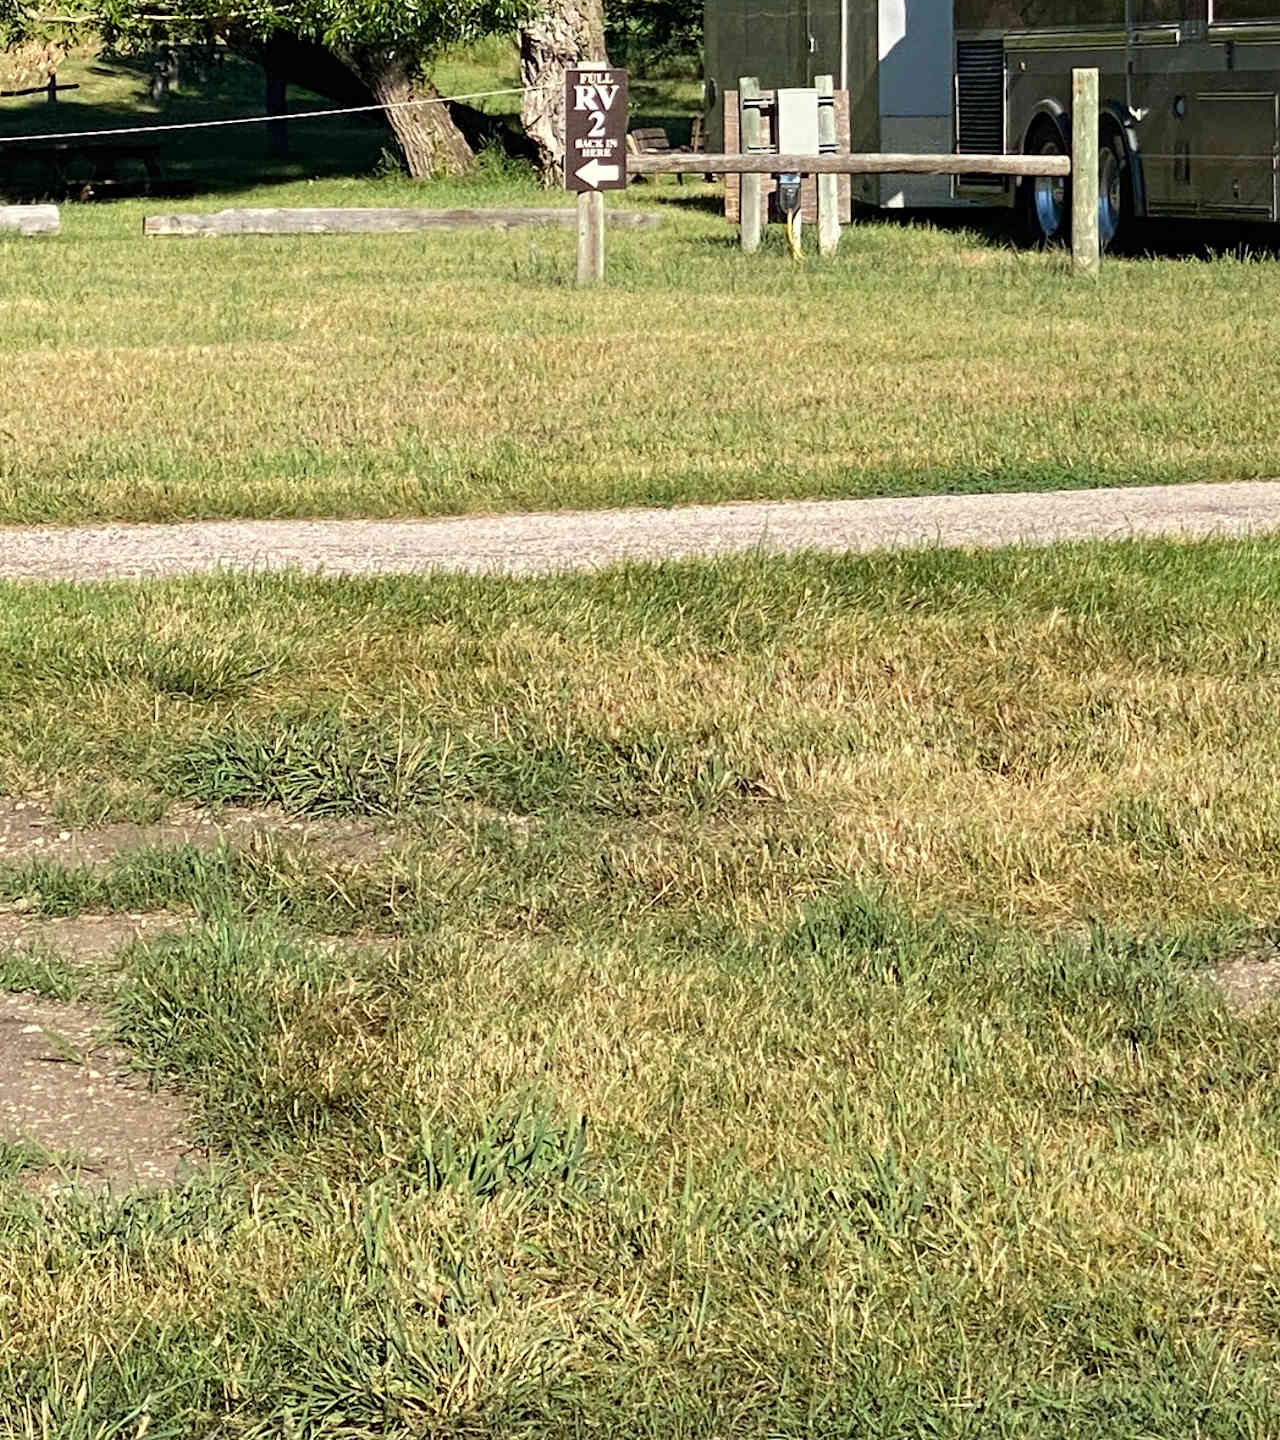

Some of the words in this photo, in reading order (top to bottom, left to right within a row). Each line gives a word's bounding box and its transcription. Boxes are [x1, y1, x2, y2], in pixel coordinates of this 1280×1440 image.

[580, 72, 614, 85] FULL
[573, 85, 620, 111] RV
[587, 111, 606, 137] 2
[575, 138, 604, 149] BACK
[605, 138, 618, 149] IN
[582, 148, 612, 158] HERE
